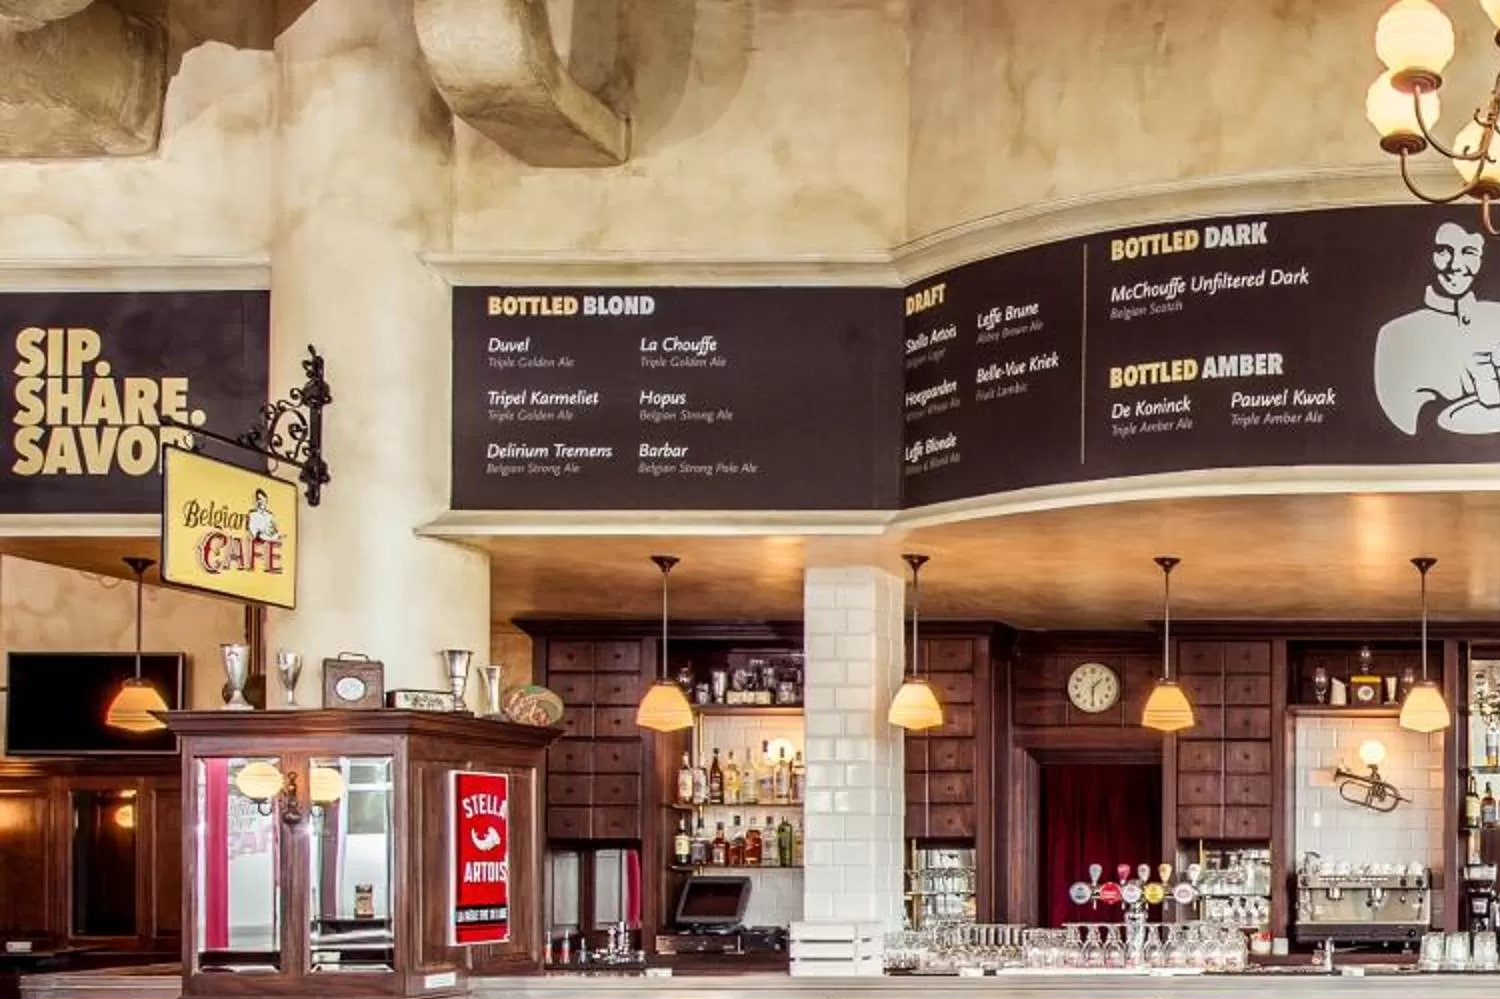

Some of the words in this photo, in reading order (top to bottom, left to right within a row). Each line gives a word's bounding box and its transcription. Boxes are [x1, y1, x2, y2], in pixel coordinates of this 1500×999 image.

[1111, 229, 1200, 262] BOTTLED
[1204, 221, 1268, 249] DARK
[1111, 276, 1187, 303] McChouffe
[1190, 269, 1266, 295] Unfiltered
[1270, 265, 1310, 286] Dark
[487, 294, 579, 317] BOTTLED
[582, 294, 655, 317] BLOND
[905, 282, 947, 317] DRAFT
[1004, 303, 1039, 321] Brune
[13, 327, 111, 378] SIP.
[487, 336, 531, 354] Duvel
[640, 336, 658, 352] La
[661, 335, 718, 357] Chouffe
[1029, 350, 1060, 372] Kriek
[1109, 358, 1199, 389] BOTTLED
[1201, 352, 1284, 379] AMBER
[12, 377, 207, 427] SHARE.
[487, 388, 527, 410] Tripel
[529, 388, 600, 406] Karmeliet
[639, 389, 687, 409] Hopus
[1111, 402, 1132, 420] De
[1135, 394, 1192, 417] Koninck
[1231, 388, 1289, 410] Pauwel
[1292, 387, 1337, 406] Kwak
[487, 442, 550, 459] Delirium
[552, 443, 613, 458] Tremens
[639, 441, 689, 458] Barbar
[182, 498, 250, 531] Belgian
[462, 793, 508, 819] STELLA
[464, 860, 508, 884] ARTOIS
